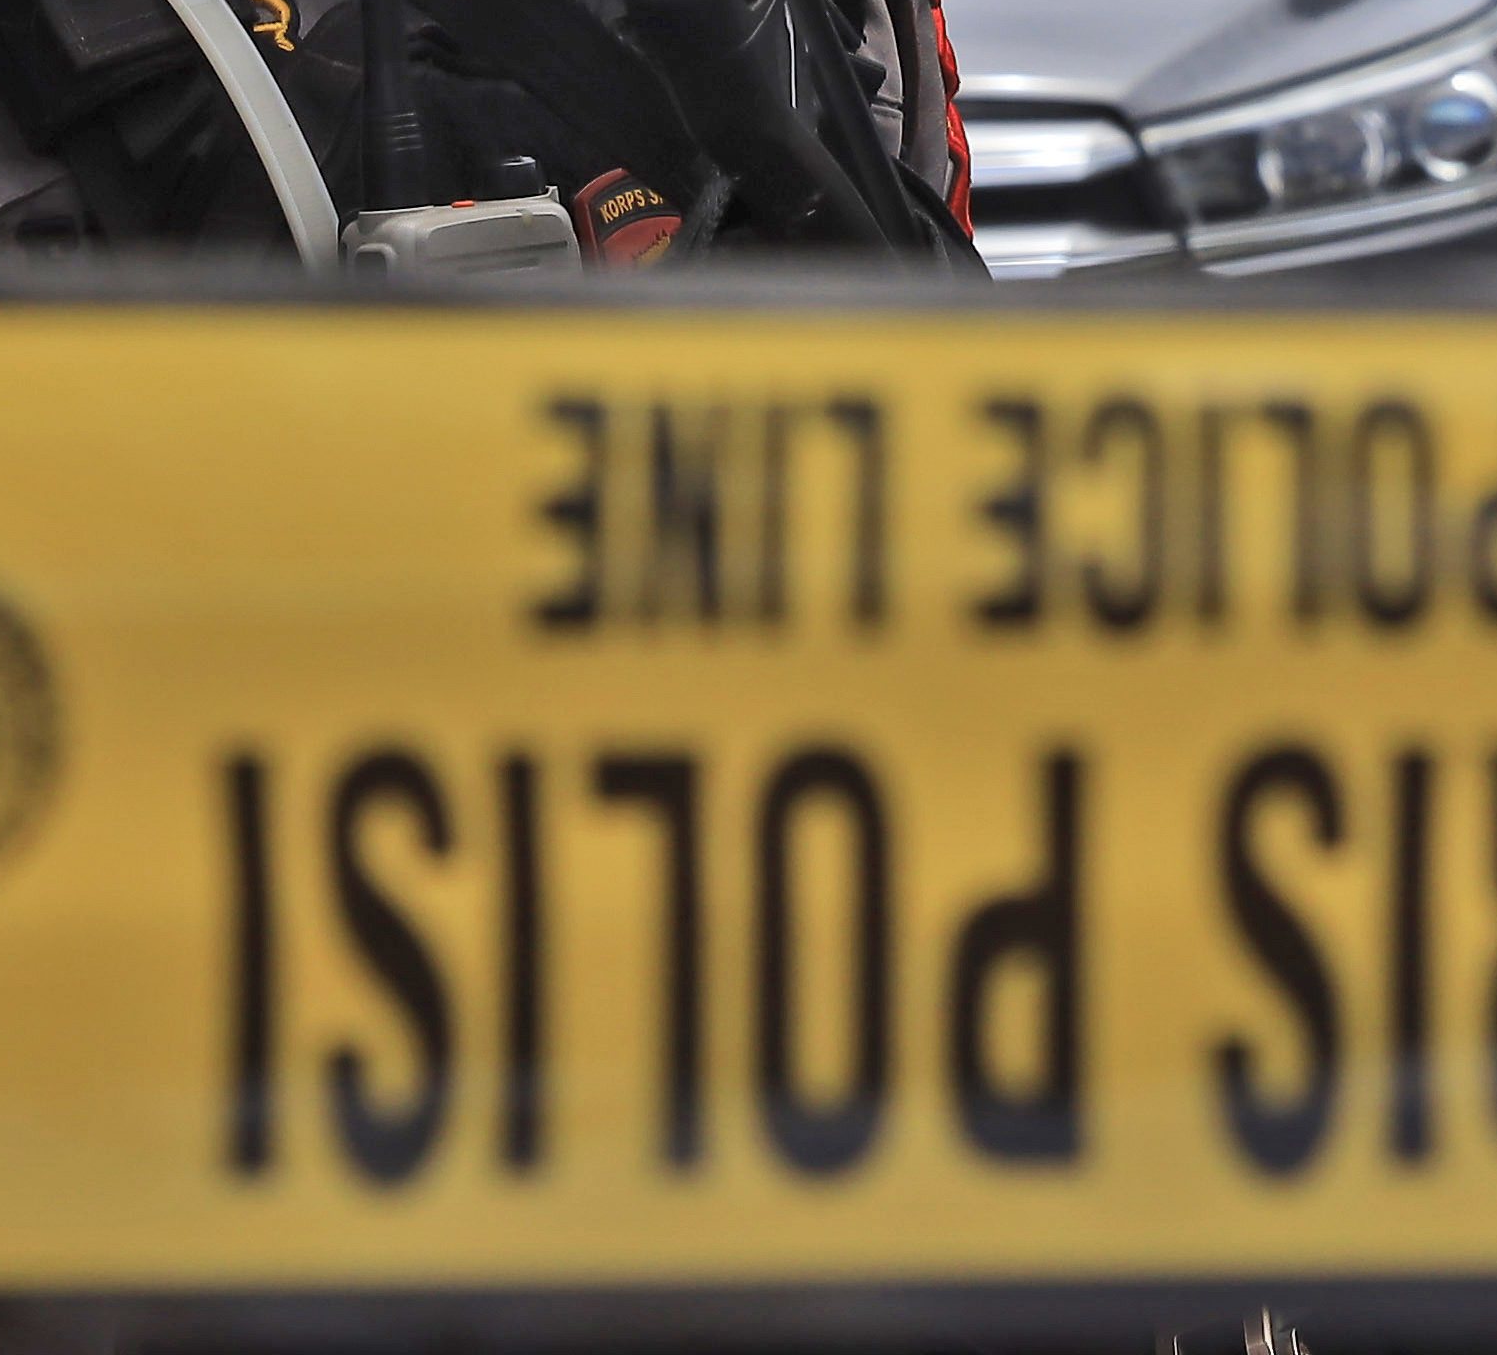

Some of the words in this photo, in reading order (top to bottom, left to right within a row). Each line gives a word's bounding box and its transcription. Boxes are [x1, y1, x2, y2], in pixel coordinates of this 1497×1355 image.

[599, 189, 646, 224] KORPS
[526, 393, 890, 633] LINE
[224, 745, 1088, 1187] POLISI
